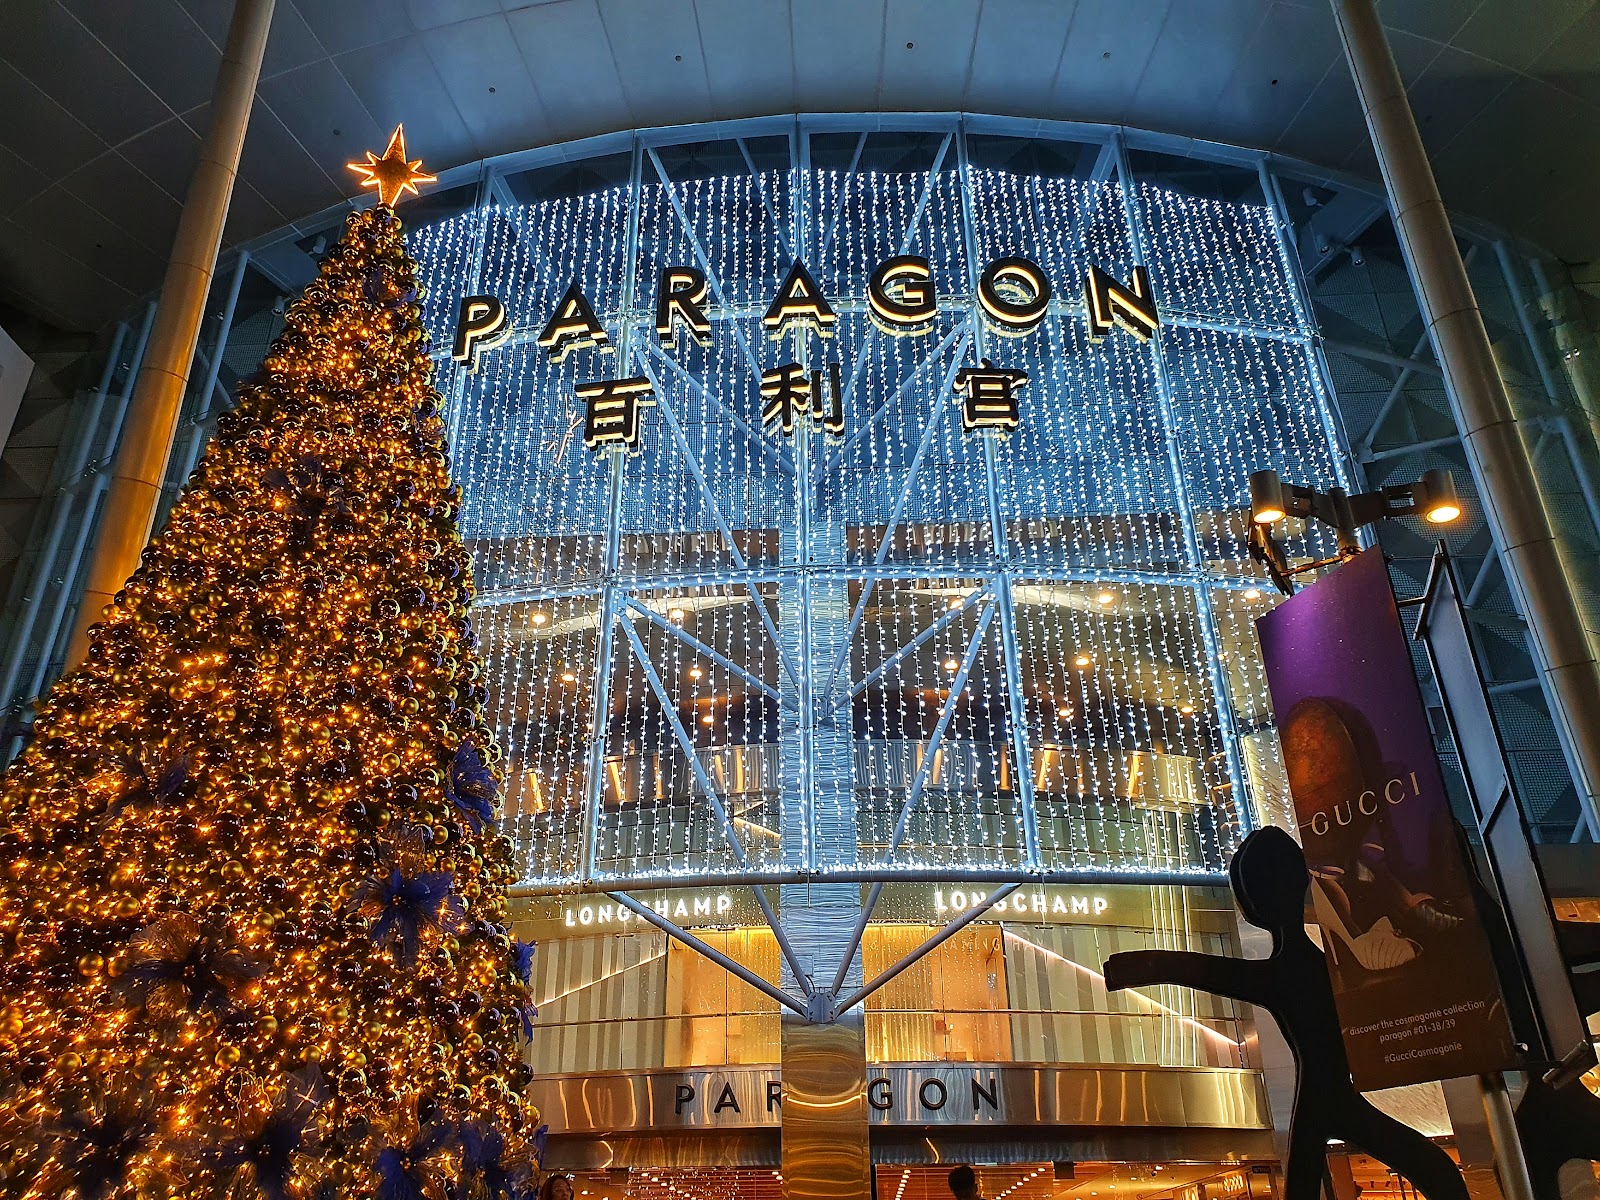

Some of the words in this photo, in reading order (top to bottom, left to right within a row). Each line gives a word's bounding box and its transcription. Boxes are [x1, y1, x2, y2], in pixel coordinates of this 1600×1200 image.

[453, 255, 1159, 367] PARAGON
[1311, 771, 1421, 836] GUCCI
[1350, 1023, 1380, 1036] discover
[1381, 1019, 1394, 1030] the
[1394, 1009, 1442, 1026] cosmogonie
[1443, 1000, 1486, 1016] collection
[1379, 1029, 1413, 1045] paragon
[1413, 1018, 1457, 1035] #01-38/39
[1384, 1041, 1463, 1063] #GucciCosmogonie
[675, 1078, 999, 1115] PARGON
